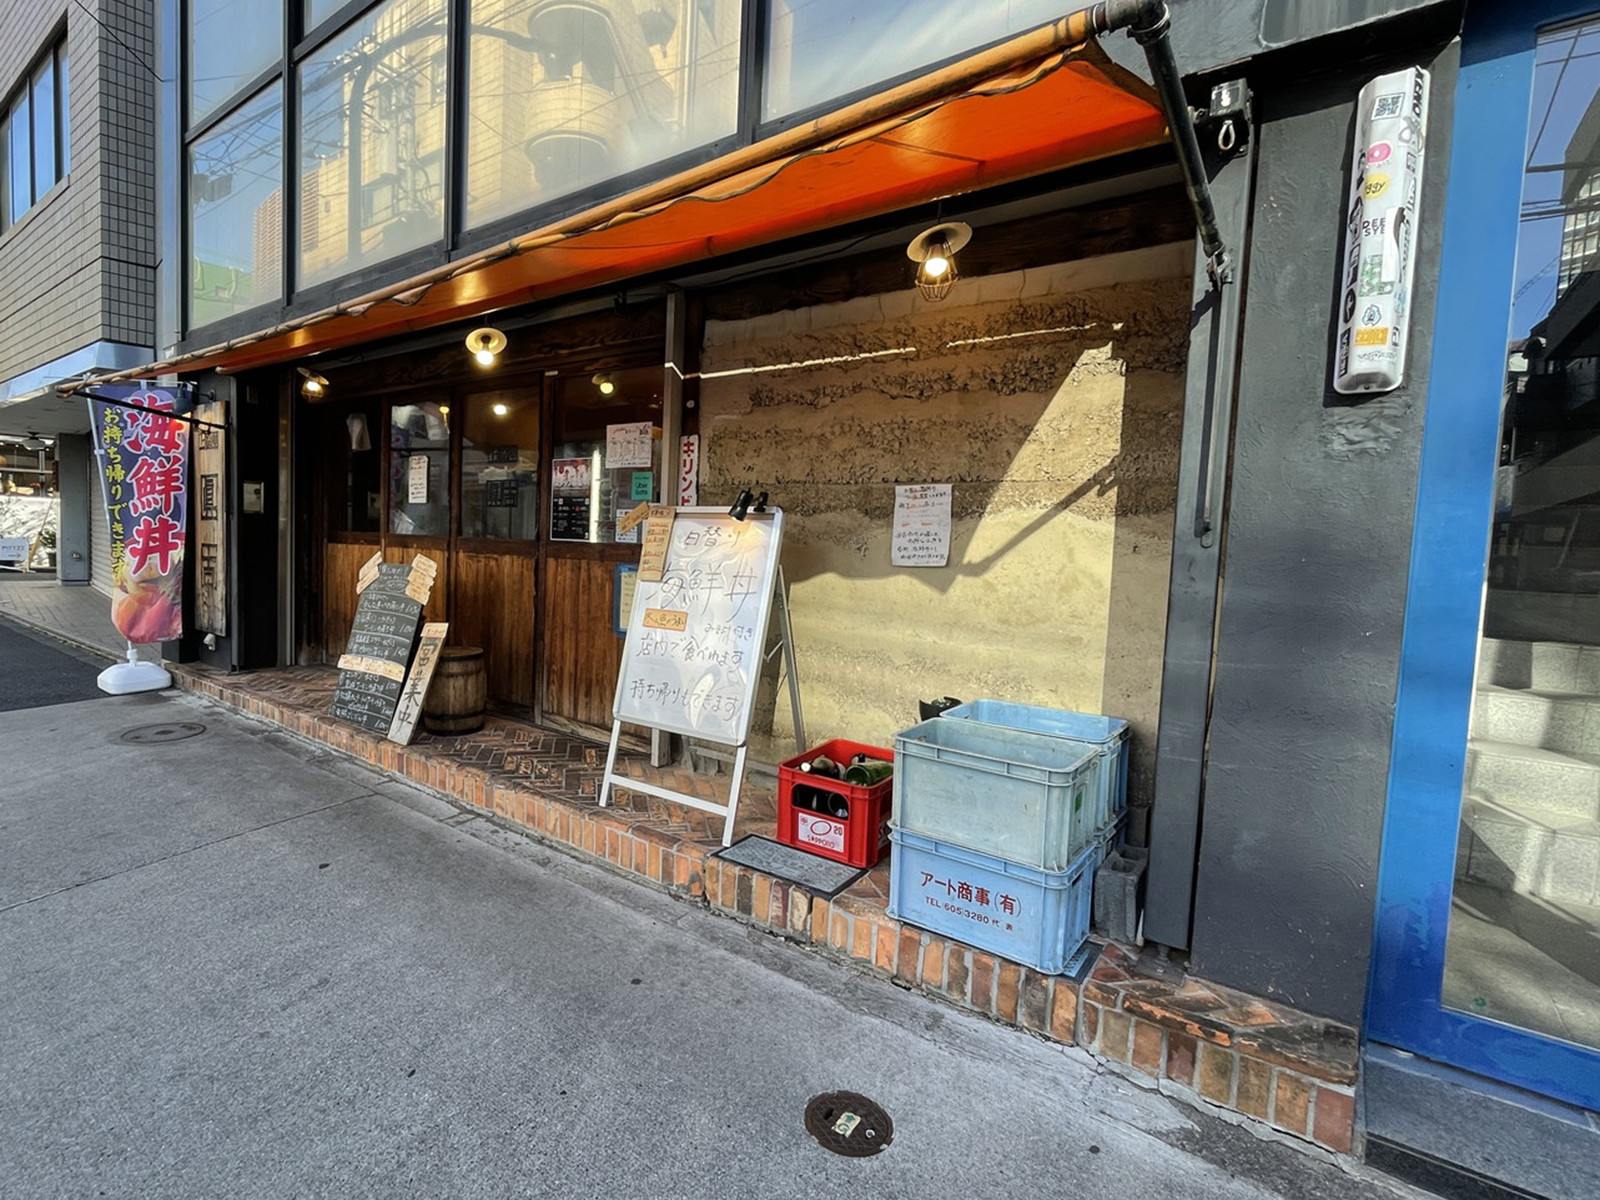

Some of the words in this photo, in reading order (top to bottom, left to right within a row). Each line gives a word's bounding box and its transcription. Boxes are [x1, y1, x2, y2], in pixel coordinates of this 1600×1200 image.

[103, 407, 127, 579] お持ち帰りできます
[124, 394, 186, 576] 海鮮丼
